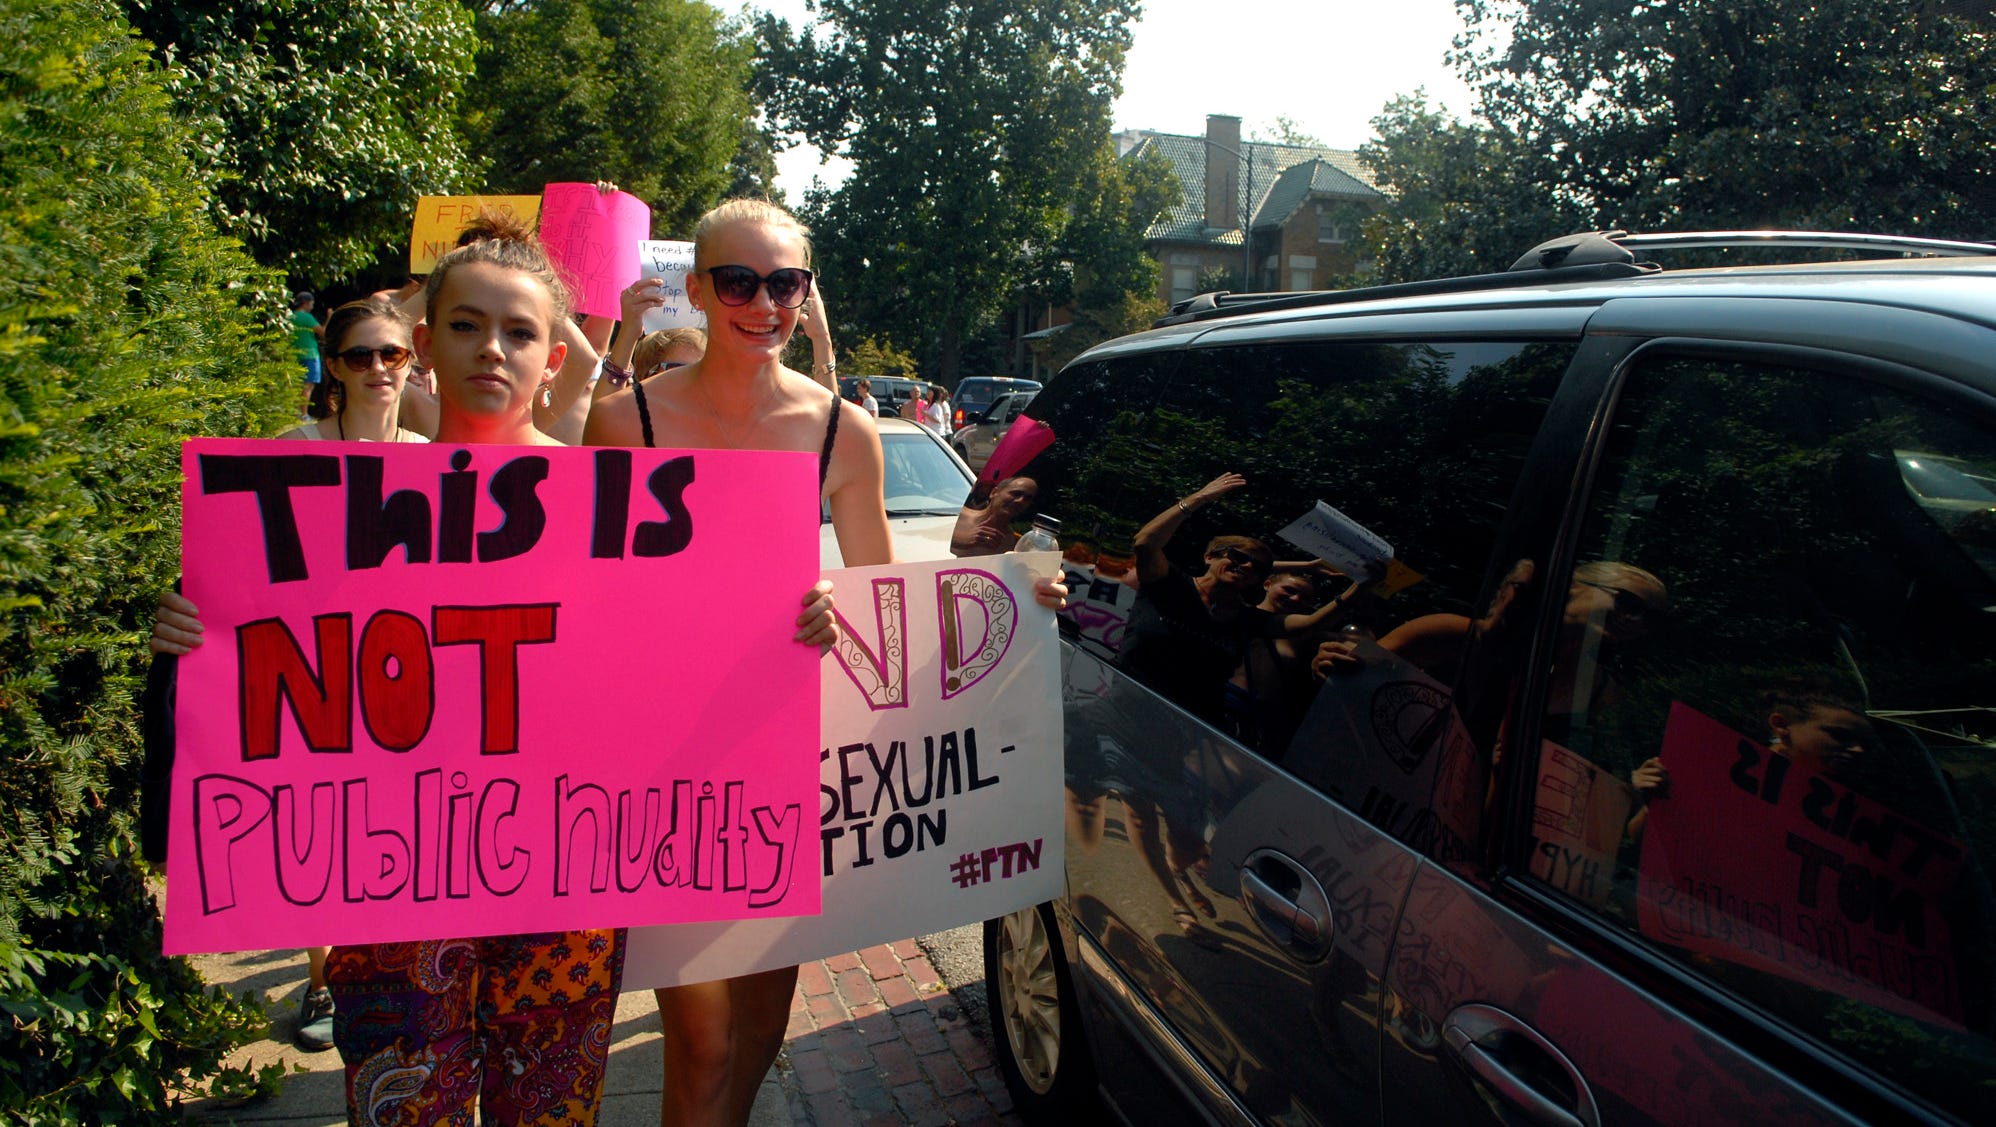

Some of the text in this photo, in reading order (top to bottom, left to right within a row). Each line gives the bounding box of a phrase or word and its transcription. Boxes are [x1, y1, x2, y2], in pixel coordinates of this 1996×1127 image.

[653, 246, 682, 255] need
[663, 306, 678, 318] my
[235, 602, 561, 762] NOT
[553, 773, 801, 909] nudity
[820, 808, 947, 876] TION
